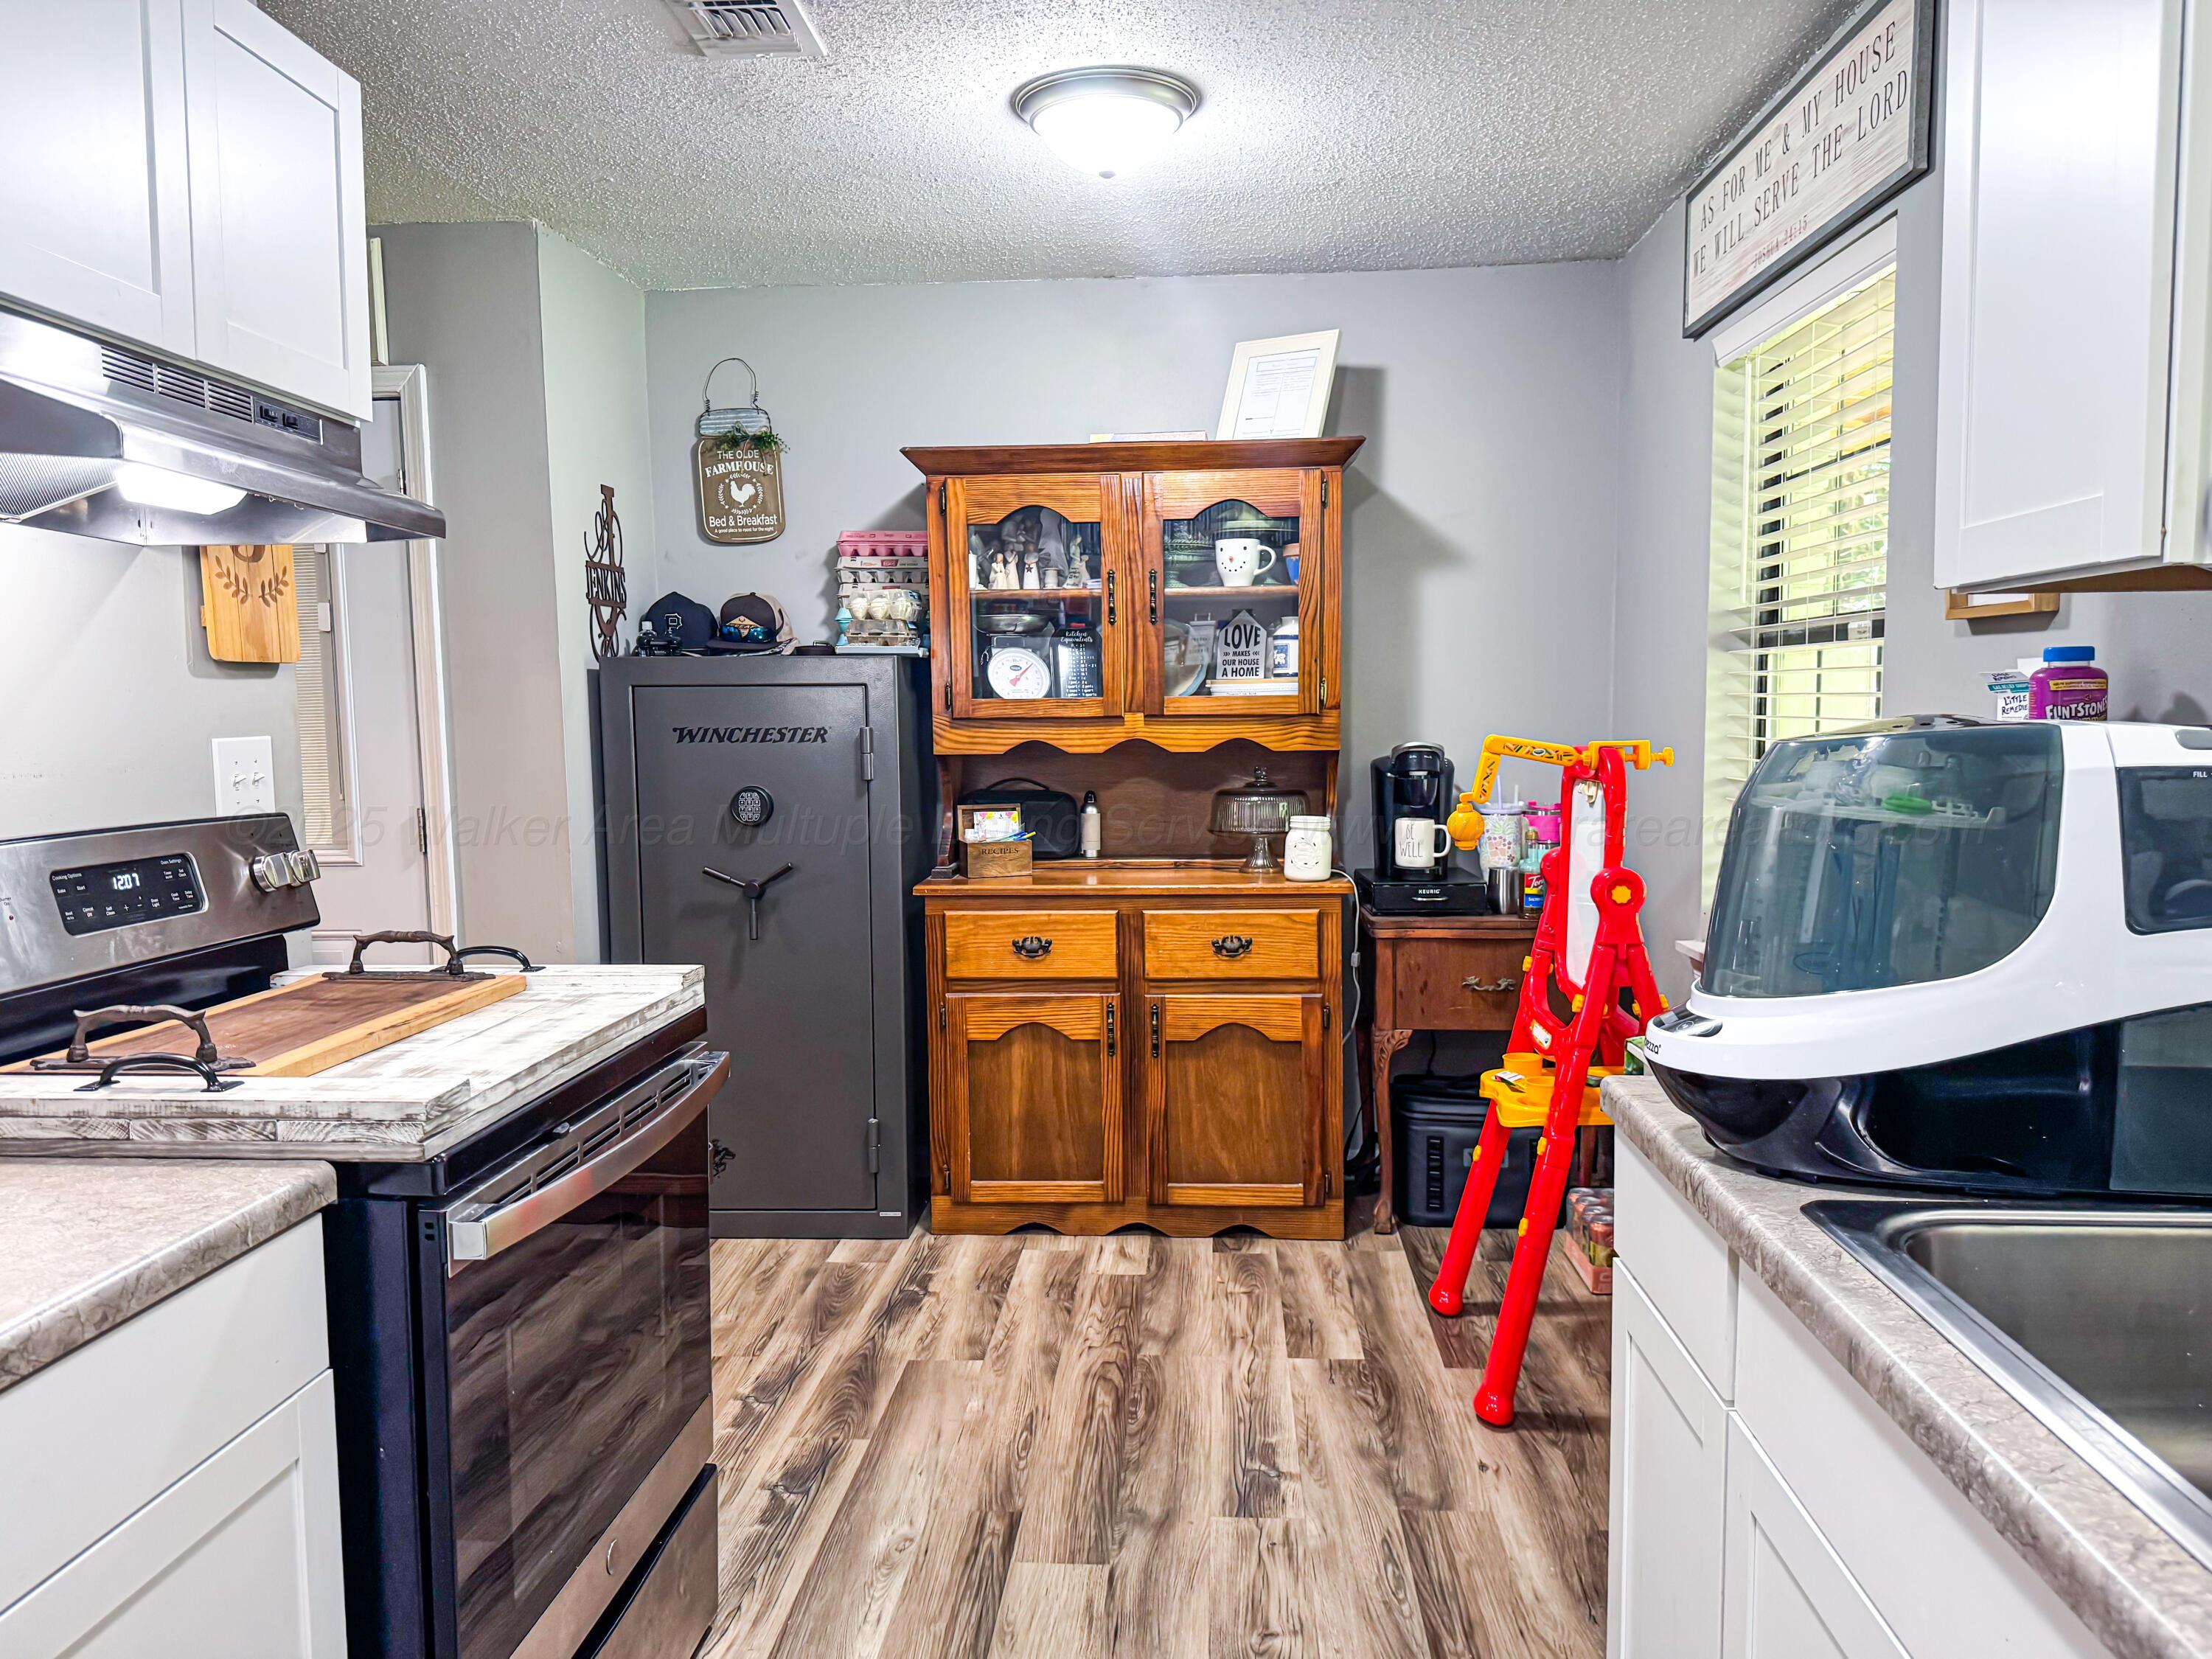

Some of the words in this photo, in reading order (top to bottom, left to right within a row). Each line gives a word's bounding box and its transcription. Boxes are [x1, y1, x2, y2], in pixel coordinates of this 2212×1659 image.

[1700, 195, 1714, 232] AS
[1722, 166, 1746, 212] FOR
[1755, 139, 1772, 181] ME
[1781, 123, 1790, 155] &
[1802, 90, 1822, 139] MY
[1834, 21, 1896, 108] HOUSE
[1693, 244, 1707, 278] WE
[1714, 212, 1745, 262] WILL
[1753, 162, 1800, 227] SERVE
[1812, 124, 1843, 178] THE
[1857, 70, 1907, 142] LORD
[717, 451, 734, 459] THE
[736, 450, 759, 459] OLDE
[709, 516, 726, 527] Bed
[728, 516, 735, 526] &
[737, 514, 778, 526] Breakfast
[586, 566, 627, 603] JENKINS
[1224, 624, 1261, 649] LOVE
[1222, 658, 1237, 667] OUR
[1222, 667, 1228, 677] A
[1231, 667, 1259, 677] HOME
[2001, 704, 2028, 716] REMEDIE
[672, 726, 829, 744] WINCHESTER
[1405, 824, 1414, 840] BE
[1399, 841, 1424, 858] WELL
[1528, 875, 1544, 889] Tor
